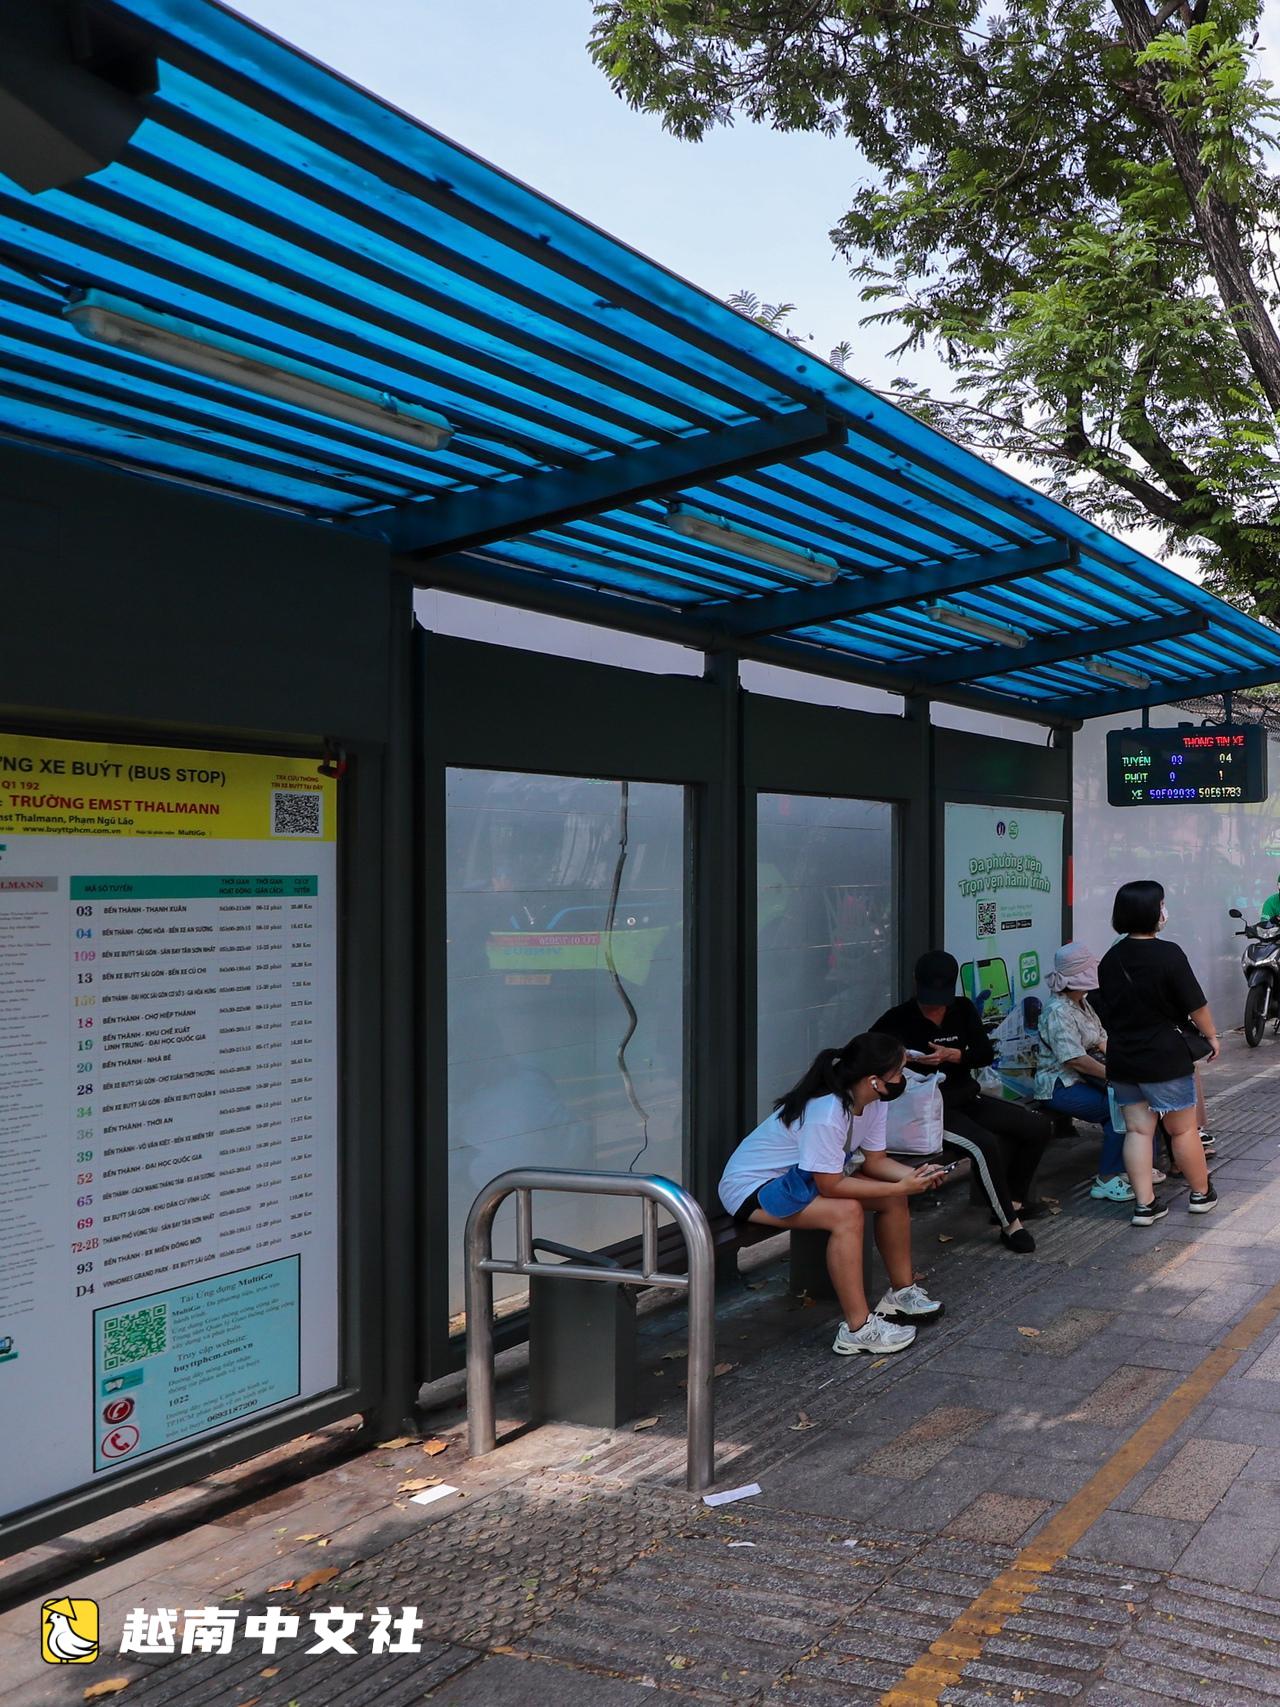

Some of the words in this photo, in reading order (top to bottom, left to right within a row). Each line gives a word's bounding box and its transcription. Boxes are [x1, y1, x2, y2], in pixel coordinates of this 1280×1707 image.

[1215, 736, 1230, 747] TIN
[1232, 735, 1244, 746] XE
[1171, 754, 1183, 765] 03
[1219, 753, 1232, 764] 04
[0, 756, 33, 772] NG
[40, 759, 66, 774] XE
[72, 760, 123, 778] BUÝT
[128, 765, 171, 782] (BUS
[176, 768, 226, 788] STOP)
[2, 780, 16, 790] Q1
[20, 781, 40, 791] 192
[1131, 789, 1143, 800] XE
[9, 794, 84, 809] TRƯỜNG
[89, 799, 132, 811] EMST
[134, 800, 220, 815] THALMANN
[16, 813, 67, 824] Thalmann,
[69, 815, 95, 826] Phạm
[97, 815, 116, 826] Ngũ
[118, 816, 134, 825] Lão
[76, 905, 93, 917] 03
[76, 928, 92, 939] 04
[74, 950, 96, 962] 109
[78, 973, 93, 984] 13
[1023, 969, 1037, 983] Go
[78, 1017, 93, 1029] 18
[78, 1039, 93, 1051] 19
[77, 1062, 93, 1074] 20
[77, 1083, 94, 1096] 28
[77, 1106, 92, 1118] 34
[77, 1128, 93, 1140] 36
[77, 1150, 93, 1163] 39
[77, 1172, 93, 1185] 52
[77, 1194, 93, 1207] 65
[77, 1217, 93, 1230] 69
[72, 1237, 99, 1254] 72-2B
[77, 1261, 94, 1275] 93
[76, 1283, 94, 1298] D4
